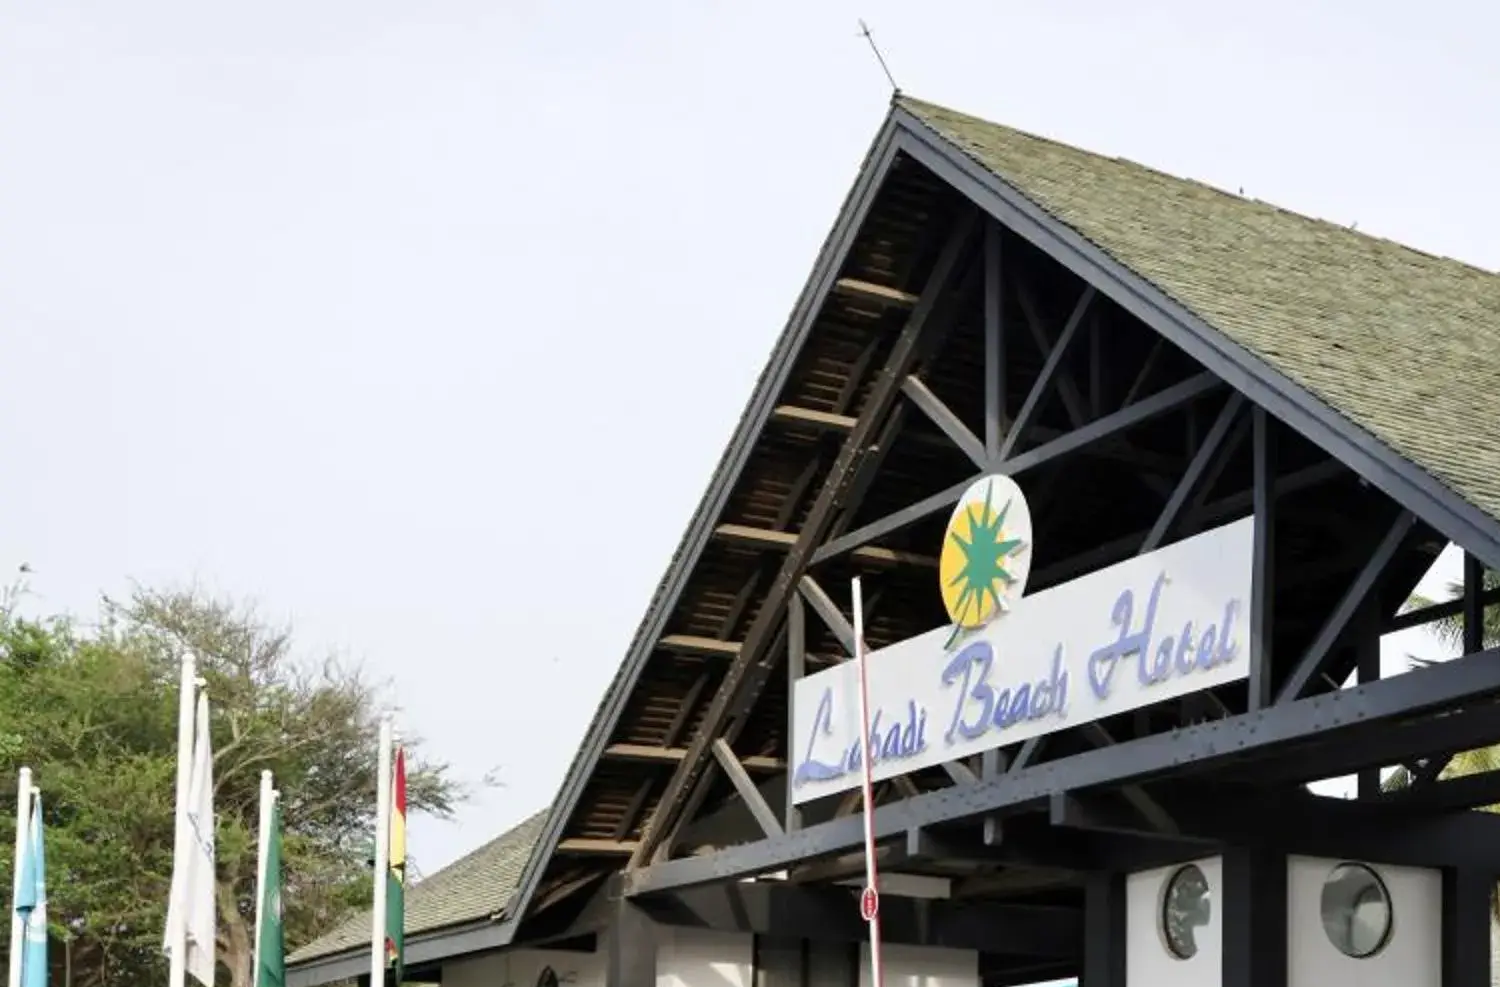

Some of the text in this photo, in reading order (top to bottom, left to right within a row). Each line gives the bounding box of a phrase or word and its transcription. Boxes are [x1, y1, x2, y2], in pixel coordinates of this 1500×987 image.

[795, 569, 1241, 788] Labadi Beach Hotel
